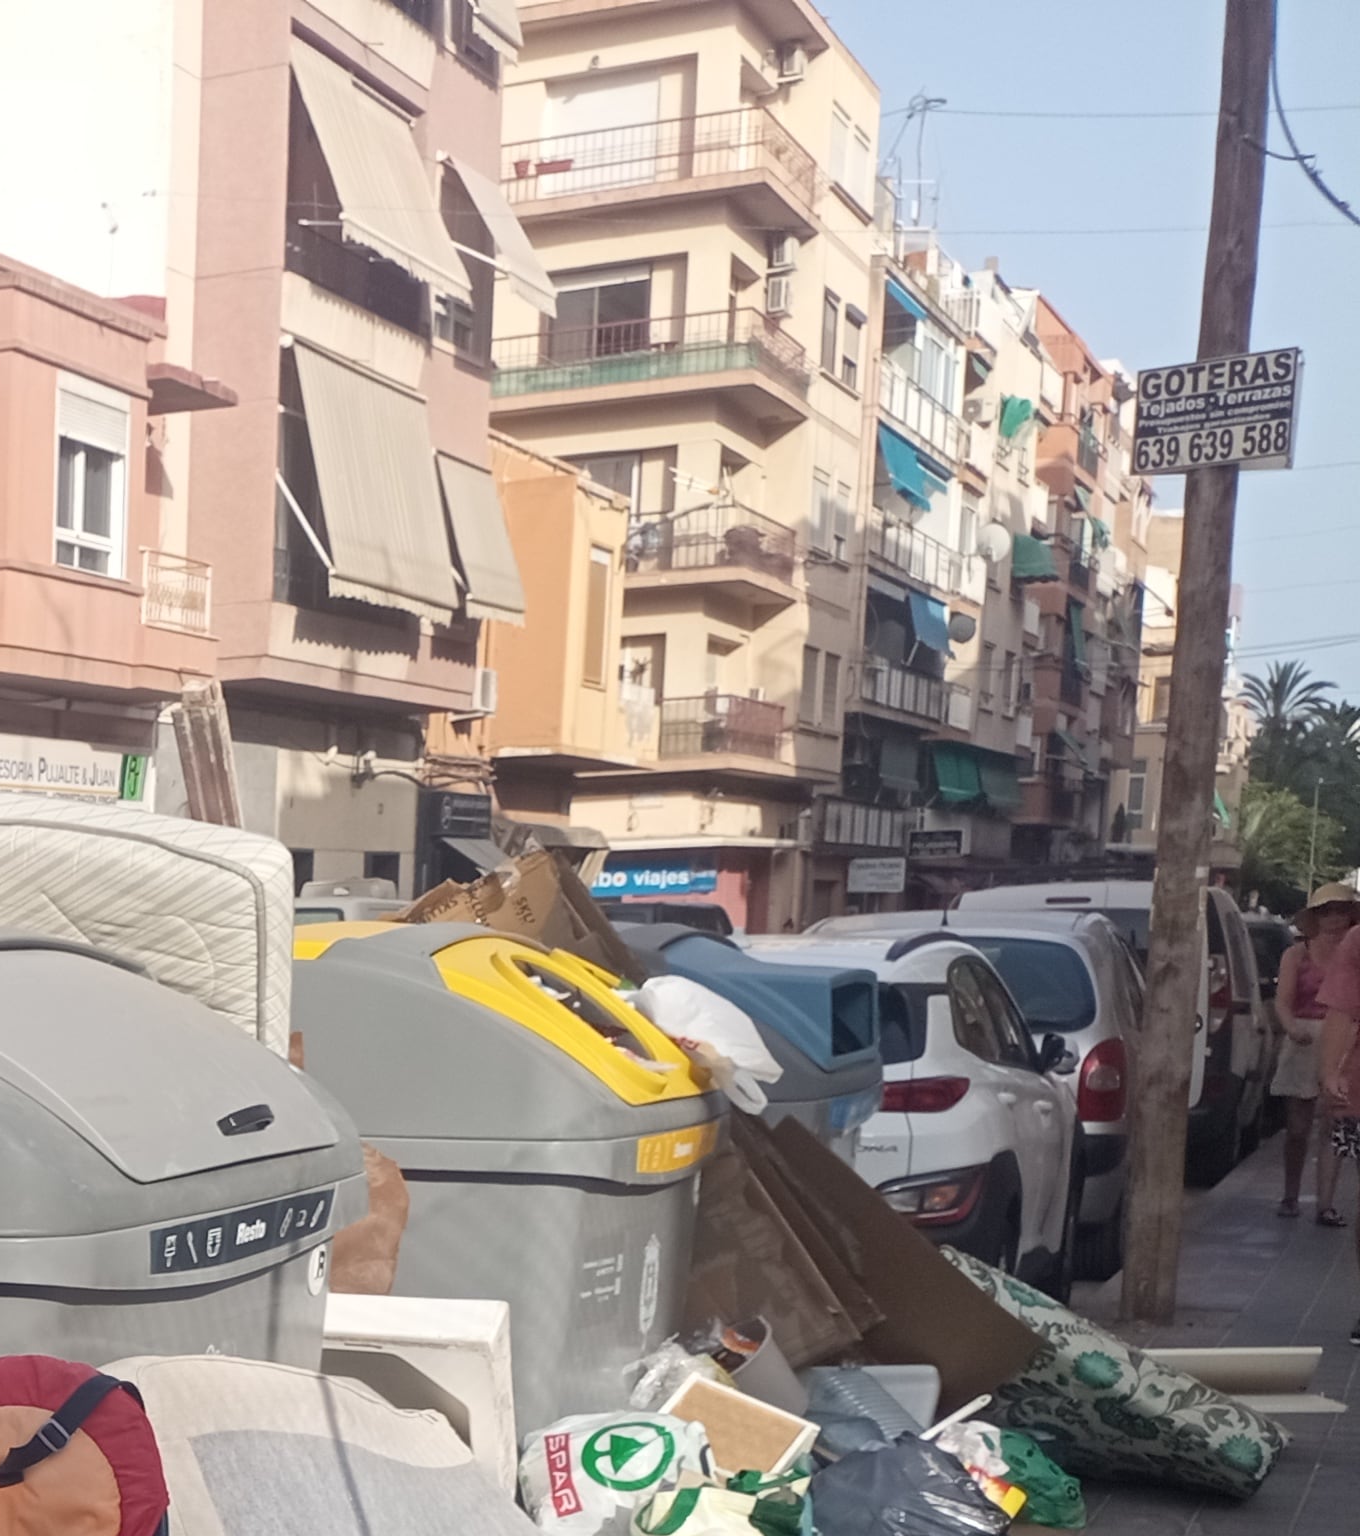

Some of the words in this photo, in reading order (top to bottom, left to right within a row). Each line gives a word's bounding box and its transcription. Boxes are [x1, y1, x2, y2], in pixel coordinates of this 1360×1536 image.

[1141, 352, 1293, 400] GOTERAS
[1140, 398, 1206, 418] Tejados
[1215, 384, 1292, 406] Terrazas
[1135, 435, 1181, 470] 639
[1188, 428, 1233, 464] 639
[1241, 421, 1288, 457] 588
[89, 763, 116, 788] JUAN
[632, 869, 690, 890] viajes
[235, 1218, 267, 1246] Resto
[547, 1434, 578, 1516] SPAR
